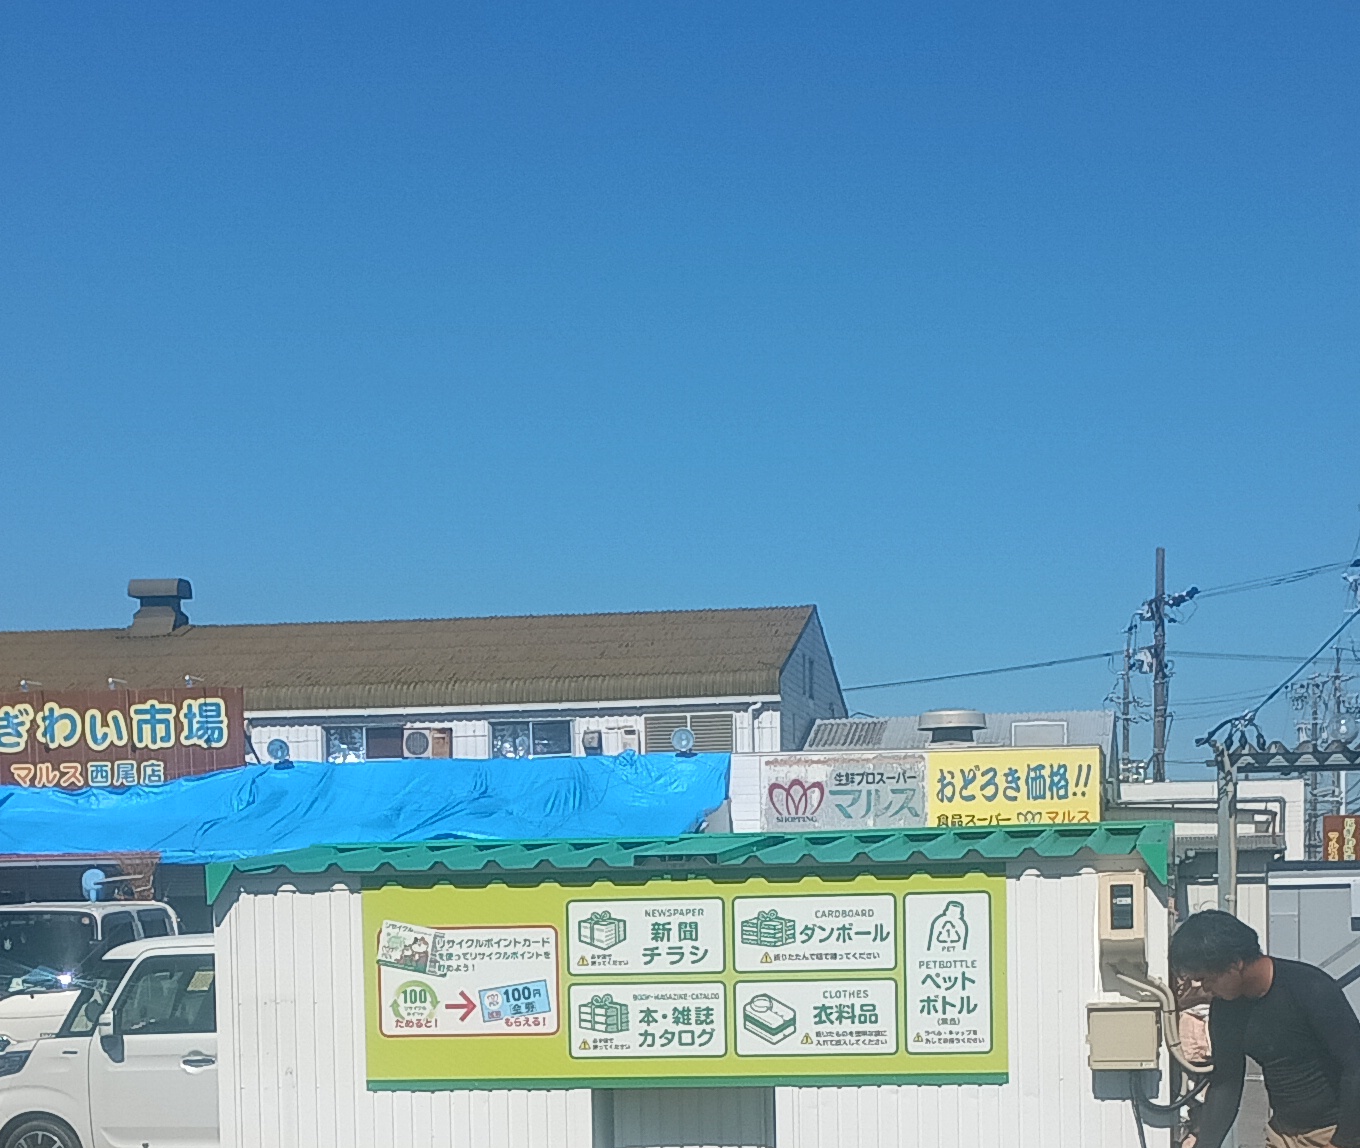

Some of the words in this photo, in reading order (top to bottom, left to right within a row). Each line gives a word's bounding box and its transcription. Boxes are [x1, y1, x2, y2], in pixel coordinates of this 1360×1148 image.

[936, 763, 1092, 803] おどろき価格!!
[829, 788, 920, 819] マルス
[644, 908, 705, 917] NEWSPAPER
[814, 909, 875, 918] CARDBOARD
[650, 921, 699, 942] 新聞
[437, 937, 551, 949] リサイクルポイントカード
[641, 945, 708, 966] チラシ
[921, 971, 976, 991] ペット
[402, 989, 428, 1004] 100
[822, 990, 869, 1000] CLOTHES
[813, 1003, 879, 1026] 衣料品
[919, 995, 978, 1016] ボトル
[638, 1006, 715, 1026] 本・雑誌
[638, 1028, 715, 1048] カタログ
